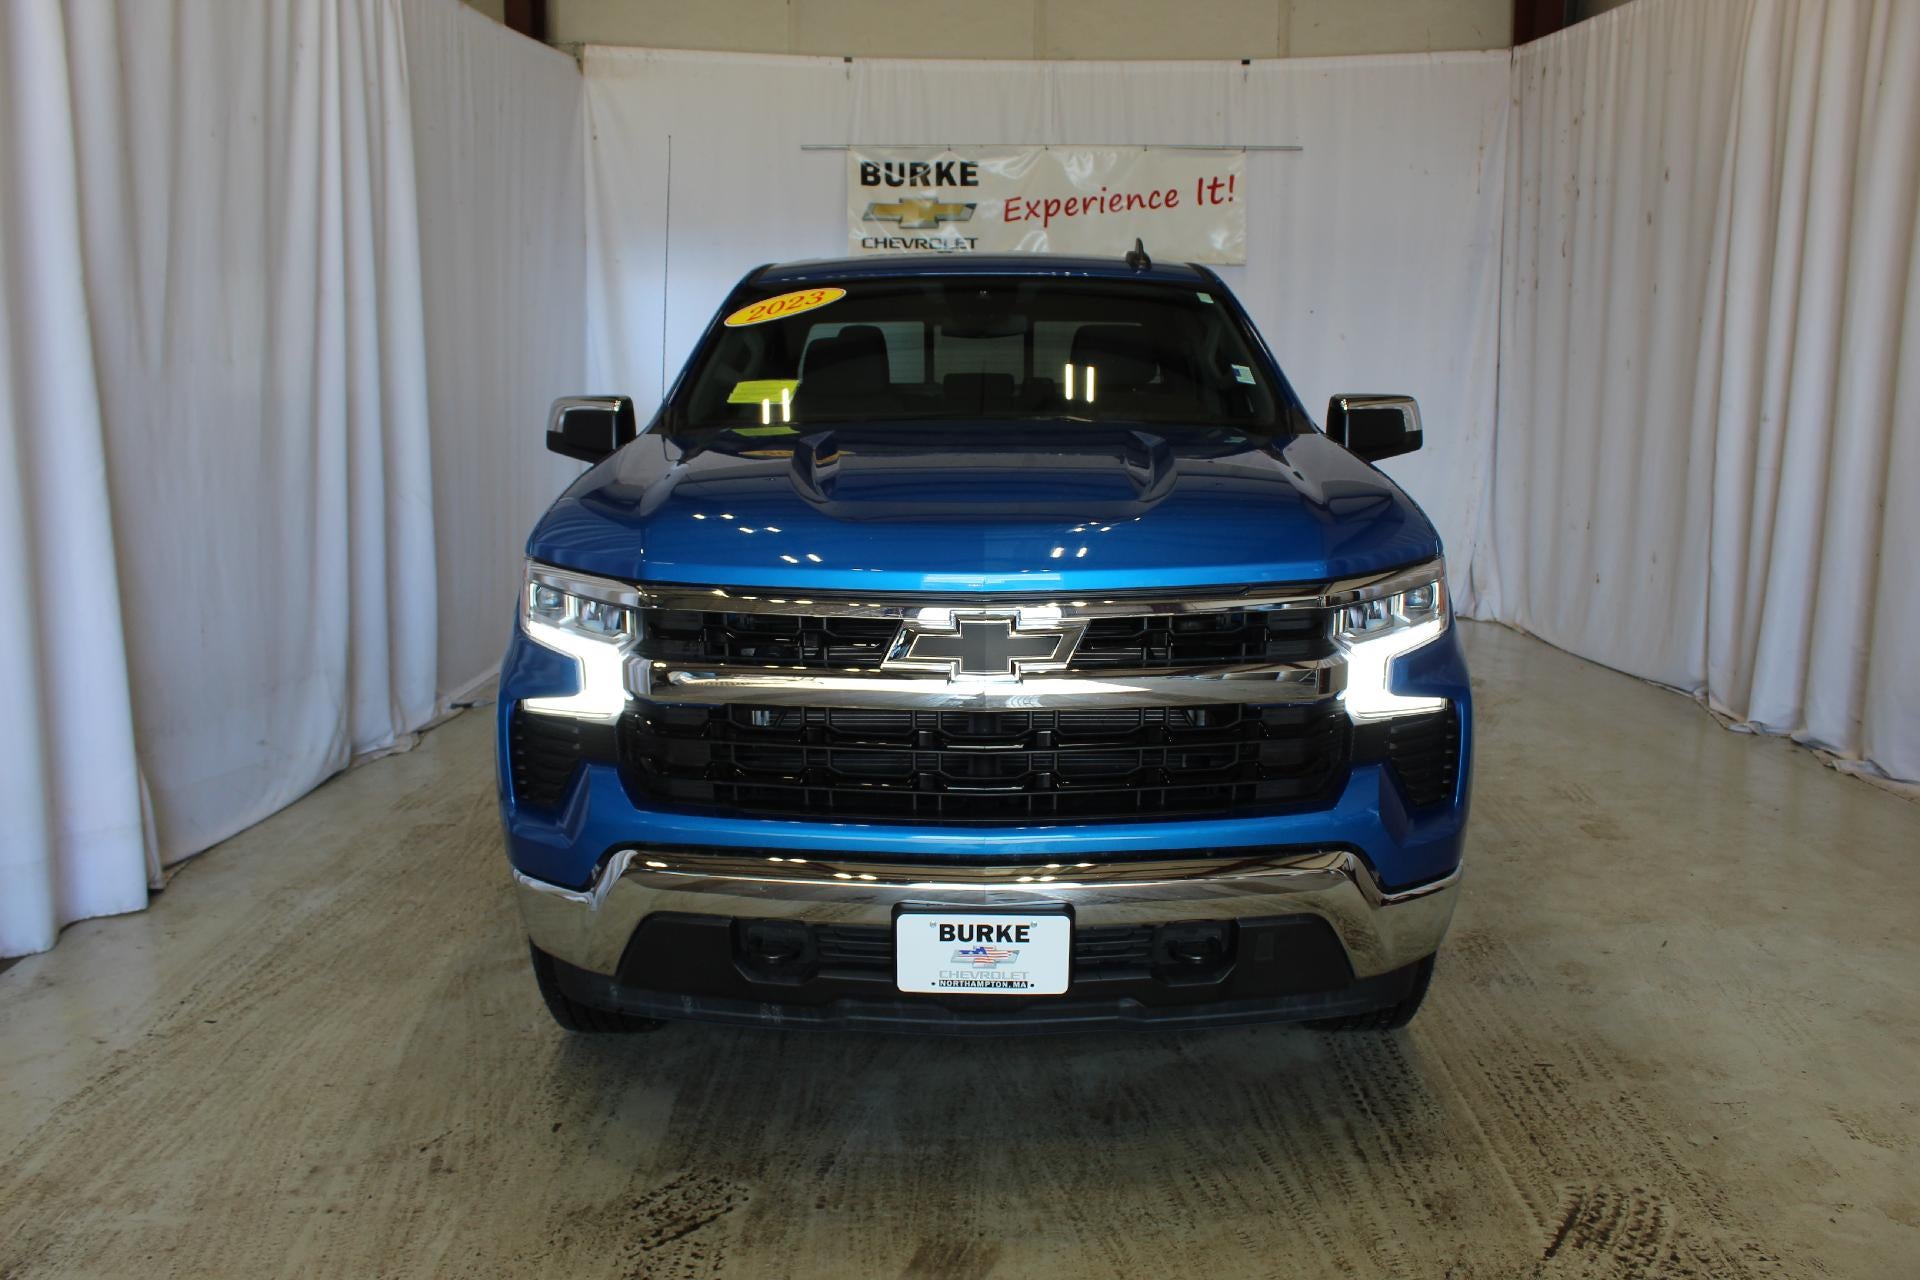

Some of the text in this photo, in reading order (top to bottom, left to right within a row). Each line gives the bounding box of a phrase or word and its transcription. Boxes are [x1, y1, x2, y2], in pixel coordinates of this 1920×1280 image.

[861, 161, 979, 187] BURKE
[1003, 174, 1235, 228] Experience It!
[862, 237, 978, 249] CHEVROLET
[746, 290, 826, 321] 2023
[939, 923, 1031, 943] BURKE
[938, 970, 1029, 980] CHEVROLET
